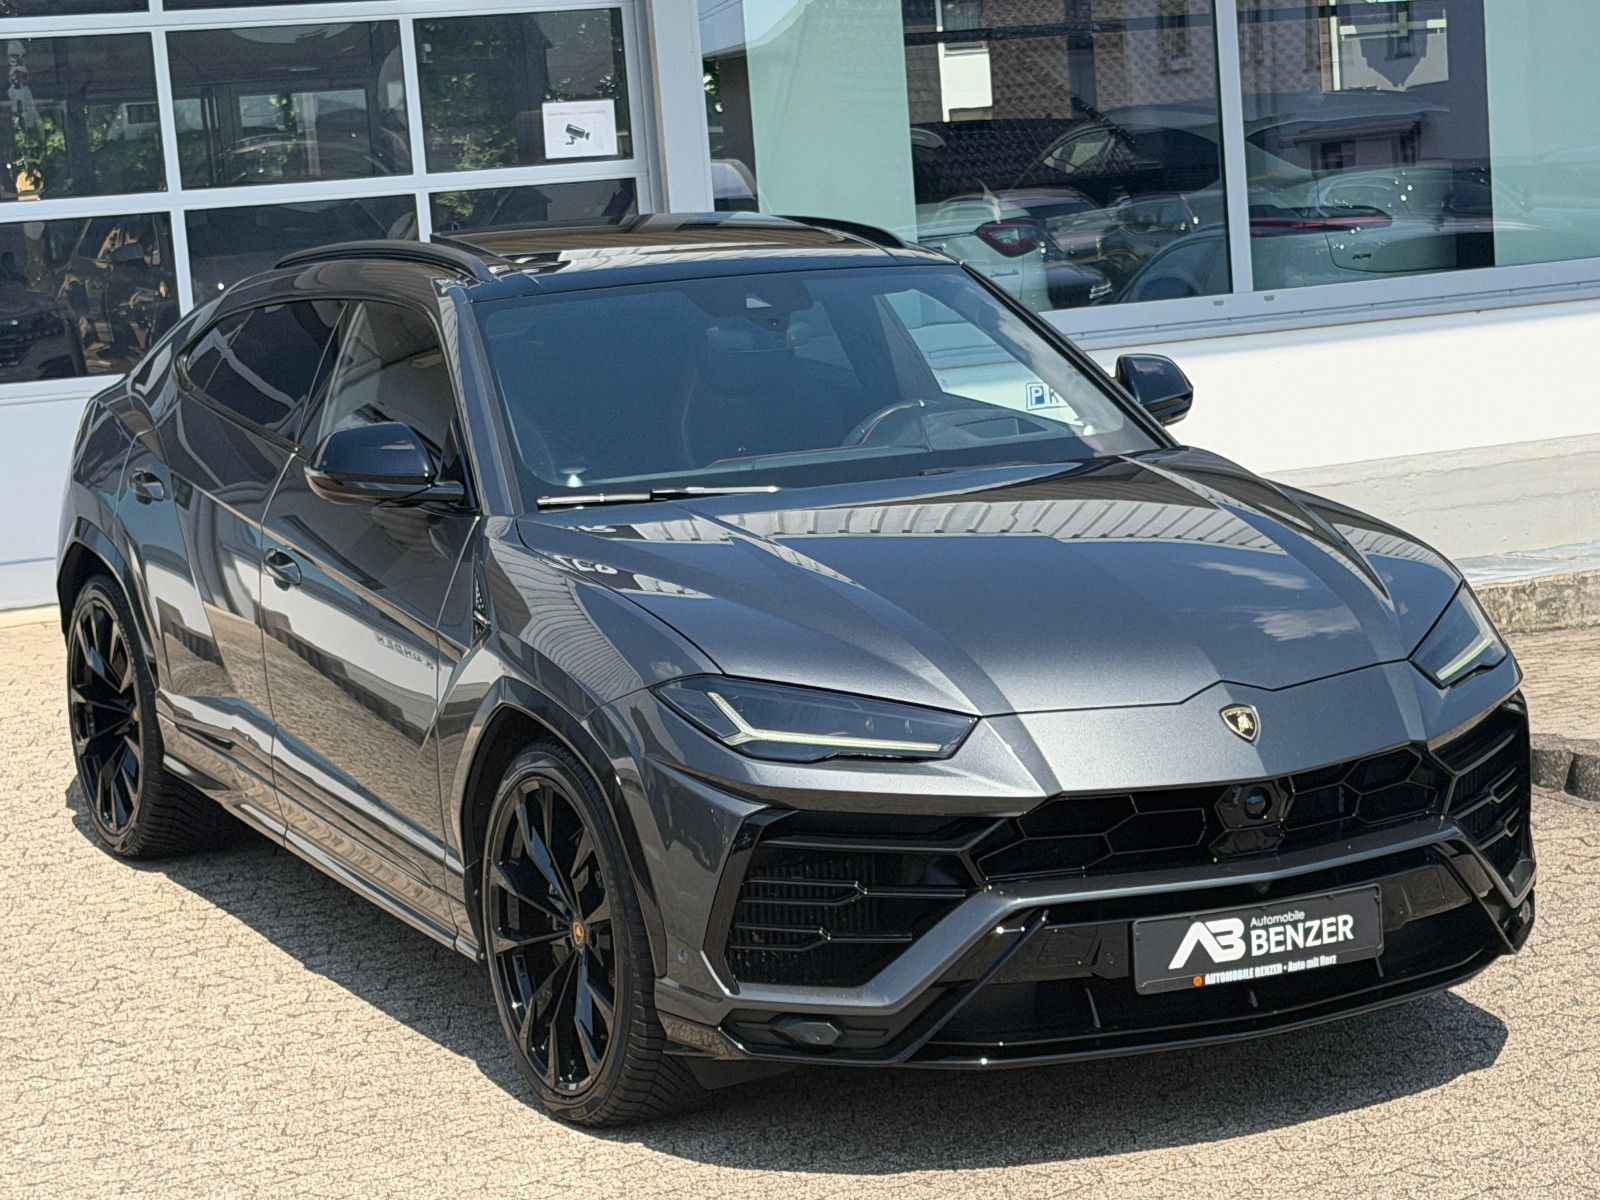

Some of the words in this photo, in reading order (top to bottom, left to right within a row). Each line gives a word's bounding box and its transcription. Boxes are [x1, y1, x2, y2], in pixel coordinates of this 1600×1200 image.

[1251, 910, 1306, 927] Automobile
[1251, 914, 1355, 957] BENZER
[1168, 917, 1247, 970] AB
[1204, 967, 1254, 986] AUTOMOBILE
[1287, 960, 1306, 973] Auto
[1306, 957, 1320, 969] mit
